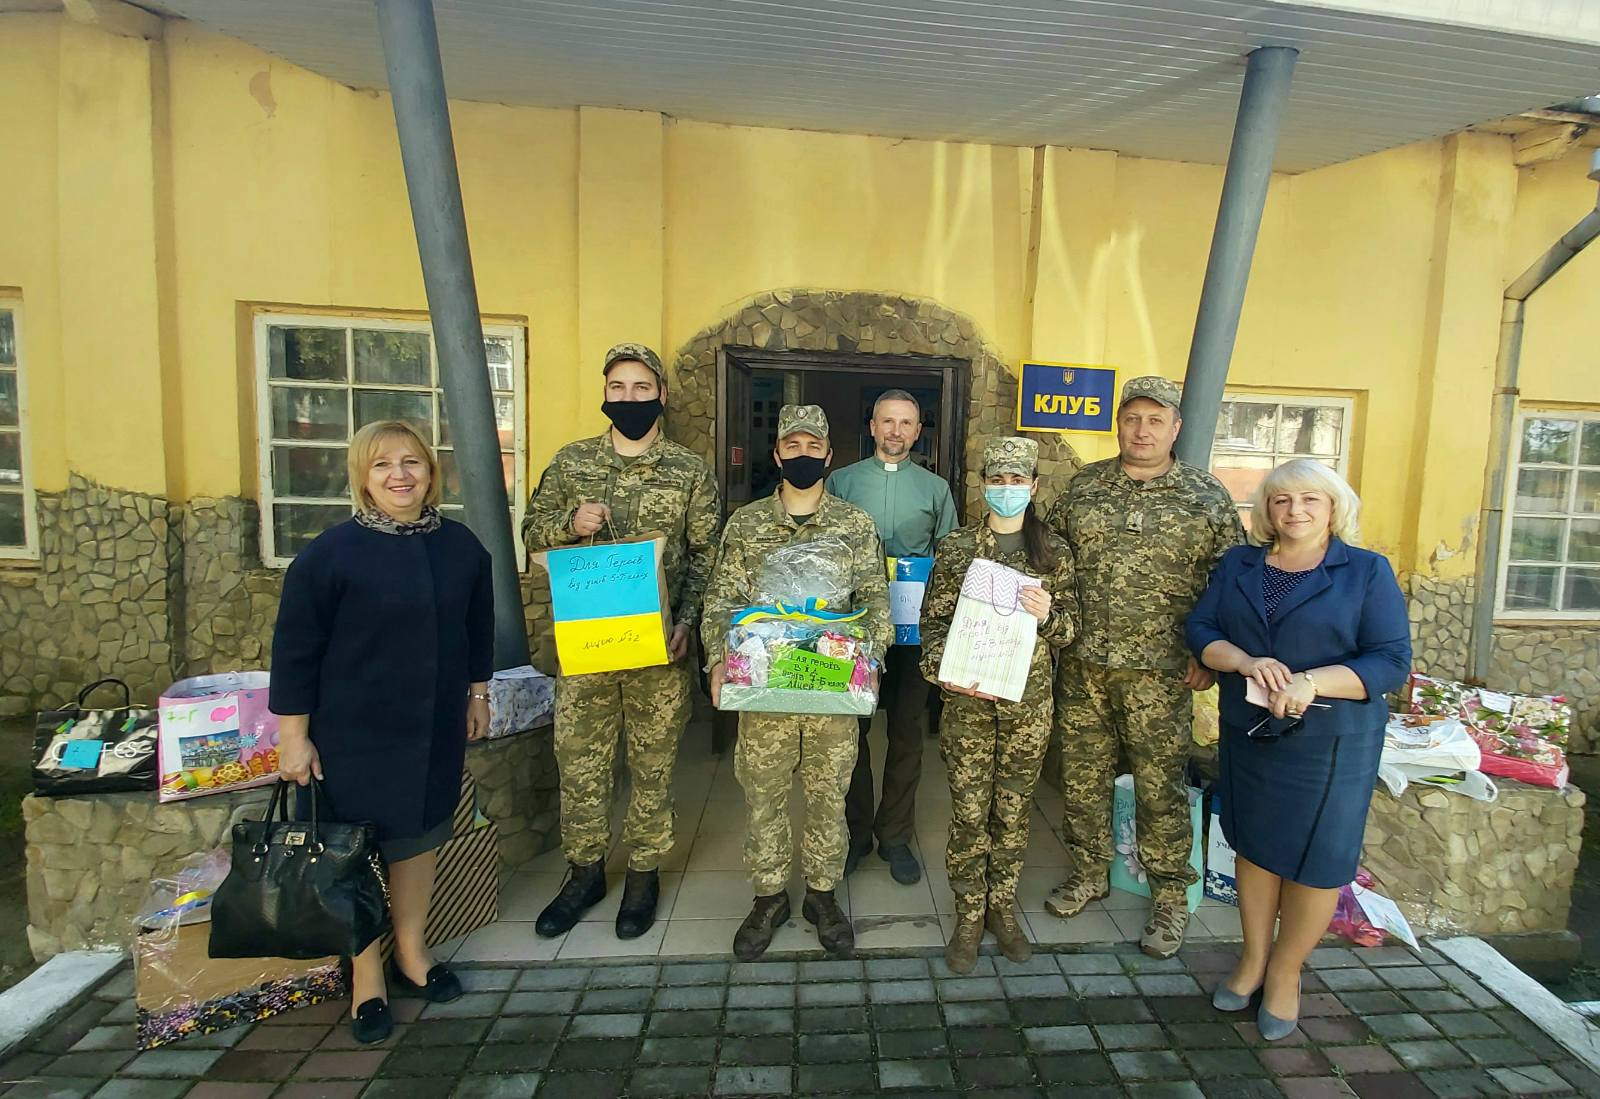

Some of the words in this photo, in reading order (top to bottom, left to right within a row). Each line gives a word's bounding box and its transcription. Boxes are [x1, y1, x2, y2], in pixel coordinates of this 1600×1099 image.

[1034, 393, 1101, 416] КЛУБ
[569, 556, 599, 573] Для
[606, 553, 643, 573] Героїв
